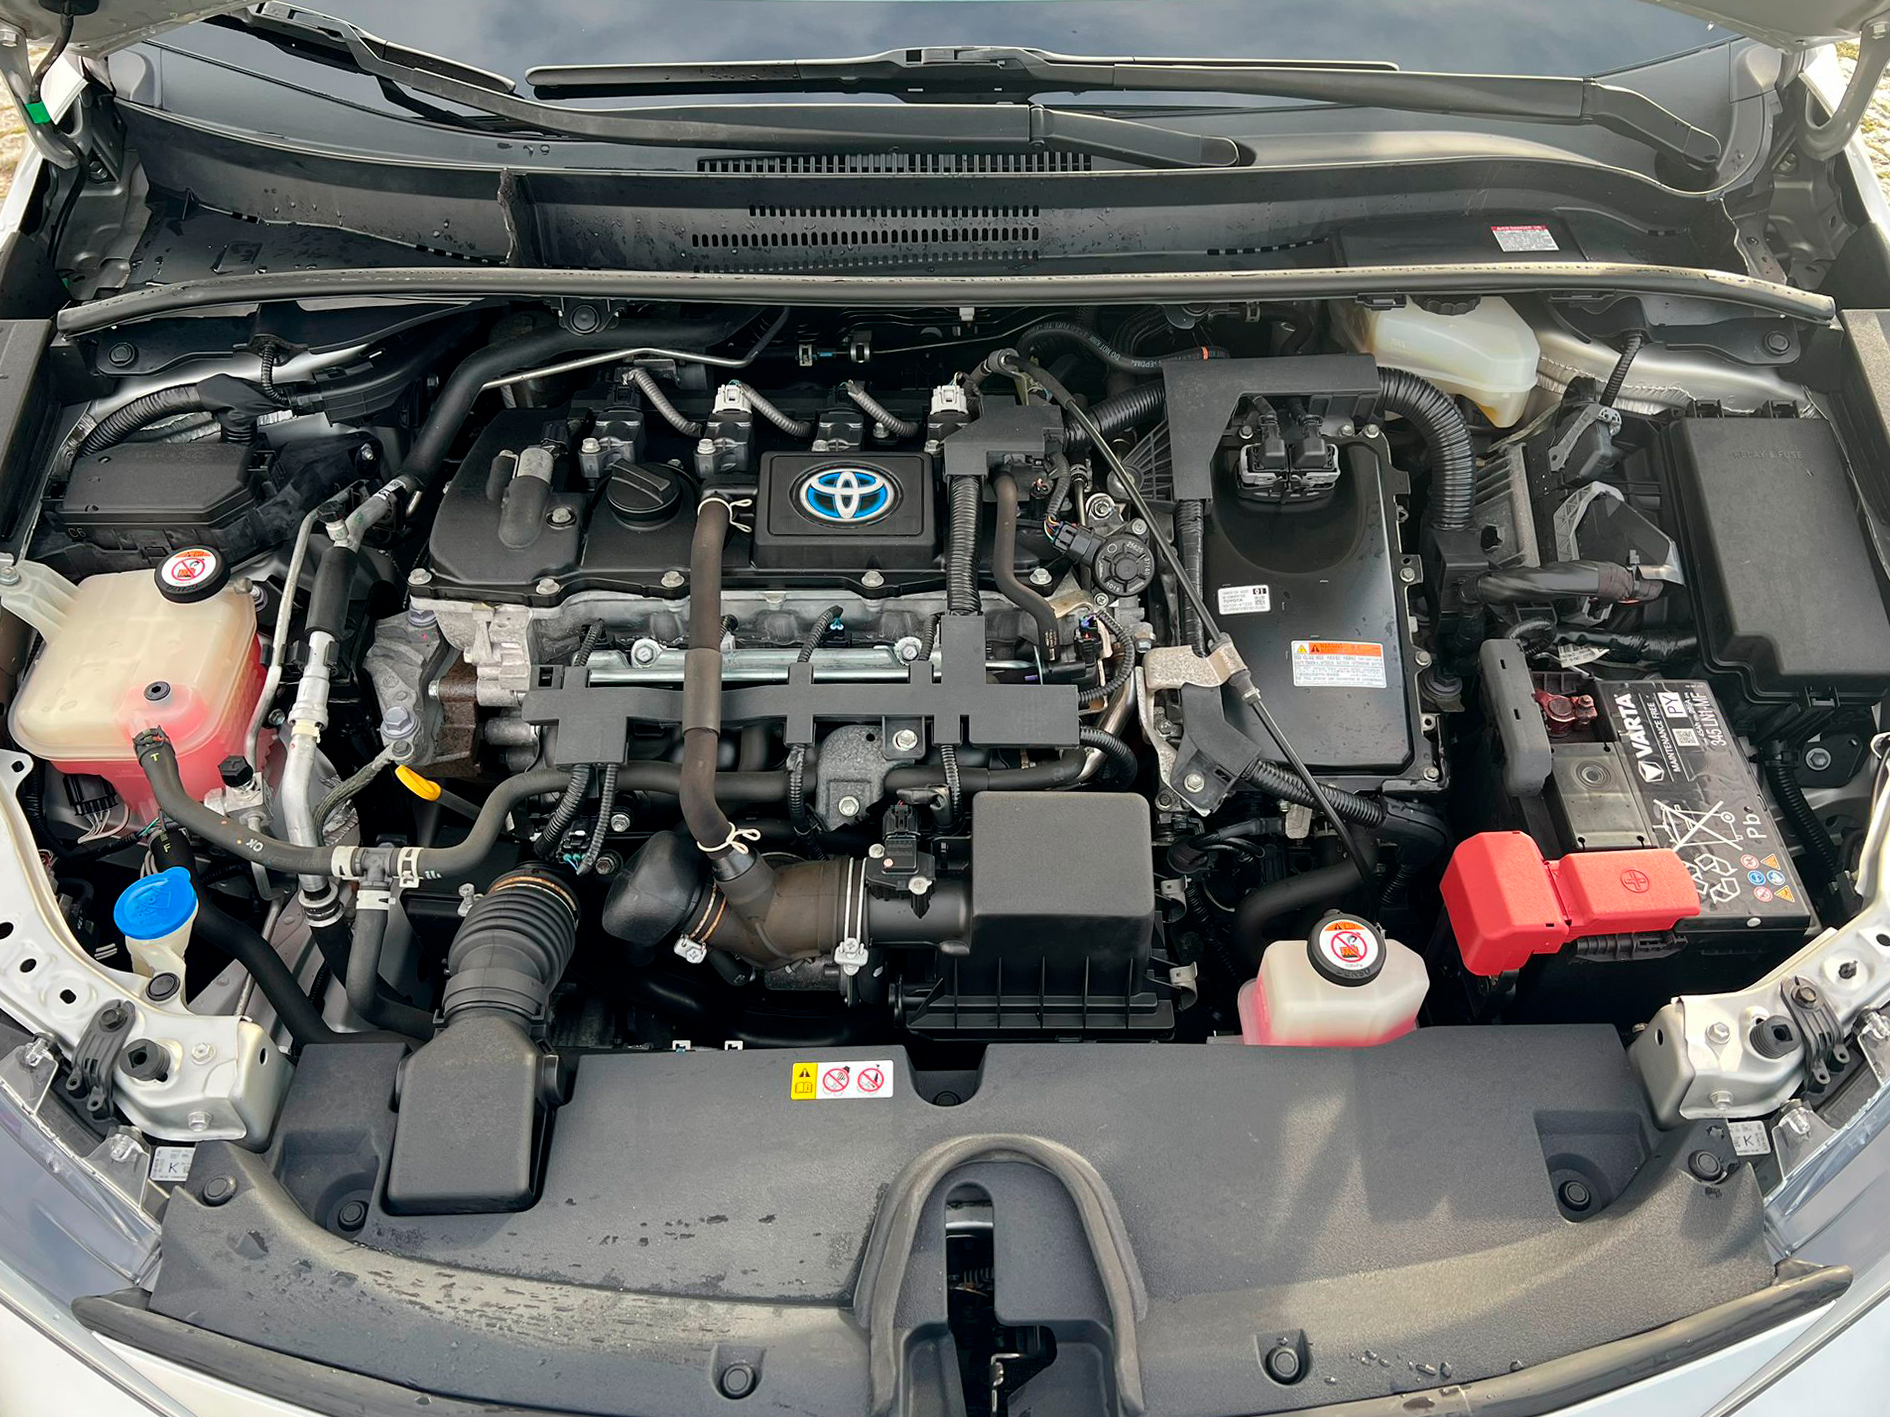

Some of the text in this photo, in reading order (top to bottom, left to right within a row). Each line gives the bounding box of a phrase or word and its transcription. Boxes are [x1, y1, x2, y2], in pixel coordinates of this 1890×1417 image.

[1099, 344, 1112, 355] NOT
[1111, 351, 1121, 361] DO
[1733, 450, 1765, 460] RELAY
[1778, 450, 1803, 459] FUSE
[1661, 694, 1683, 716] PY
[1616, 693, 1651, 759] VARTA
[1646, 701, 1681, 773] MAINTENANCE FREE
[1707, 728, 1728, 747] 345
[150, 752, 160, 762] T
[1742, 813, 1768, 840] Pb
[163, 842, 172, 853] F
[244, 837, 264, 853] OK
[1743, 1135, 1754, 1146] K
[168, 1162, 180, 1173] K
